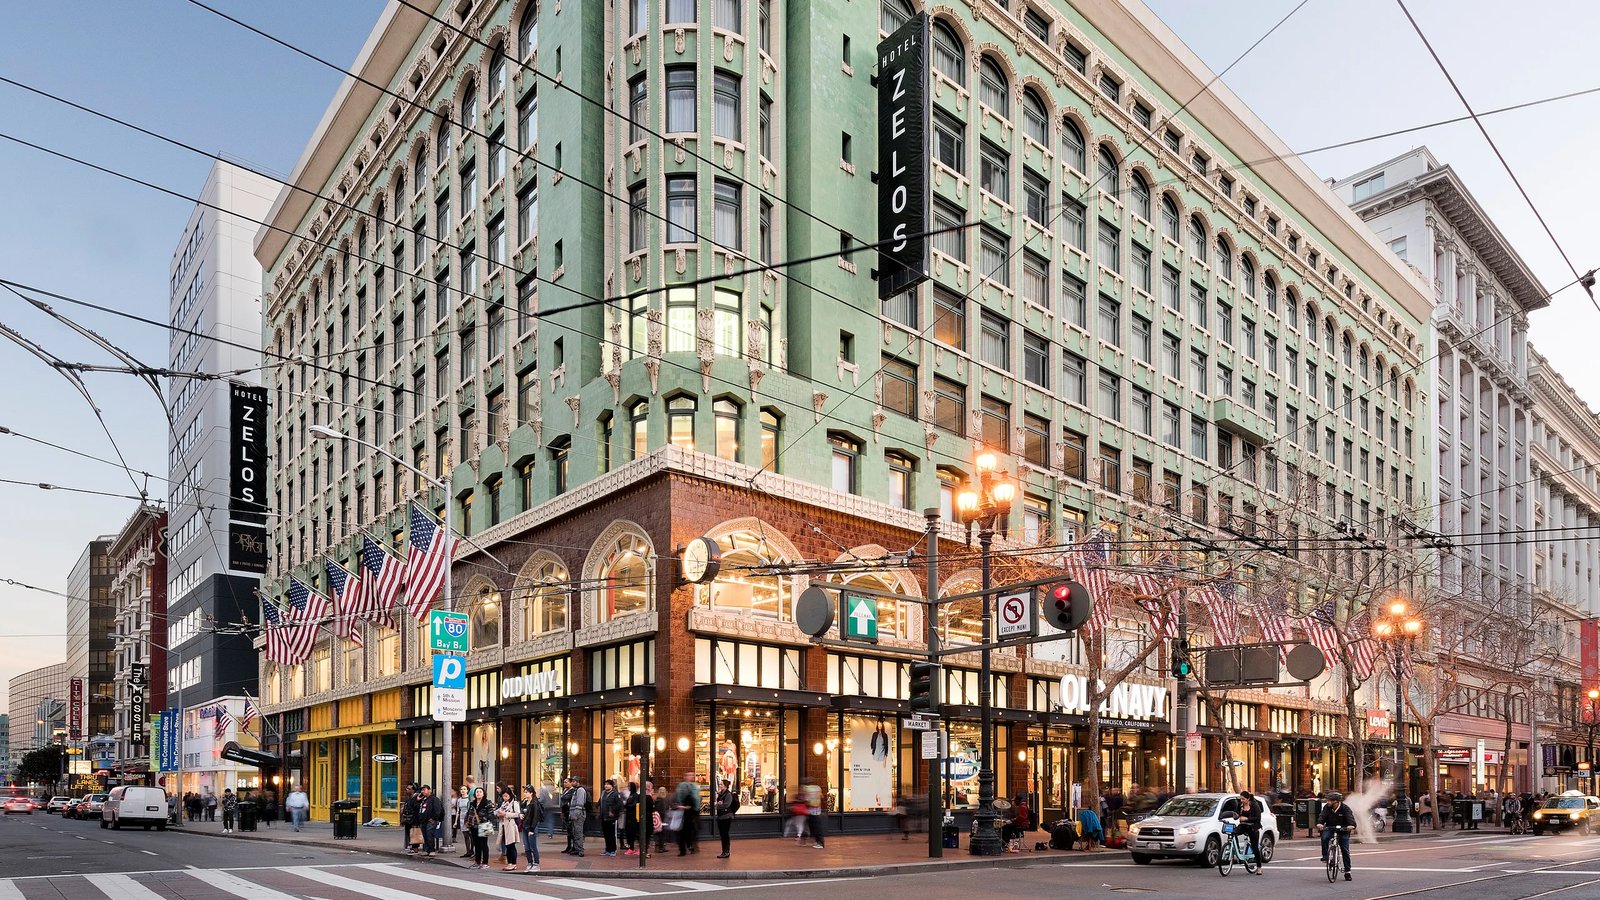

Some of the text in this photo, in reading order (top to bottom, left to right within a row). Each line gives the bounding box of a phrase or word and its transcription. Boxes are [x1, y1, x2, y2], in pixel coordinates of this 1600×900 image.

[882, 34, 917, 68] HOTEL
[892, 67, 907, 253] ZELOS
[234, 389, 263, 402] HOTEL
[241, 405, 254, 502] ZELOS
[448, 623, 463, 634] 80
[1001, 625, 1015, 633] EXCEPT
[437, 639, 462, 649] Bay Br
[133, 667, 143, 683] The
[502, 669, 558, 699] OLD NAVY
[73, 681, 81, 700] CITY
[1110, 680, 1167, 718] NAVY
[132, 685, 143, 741] MOSSER
